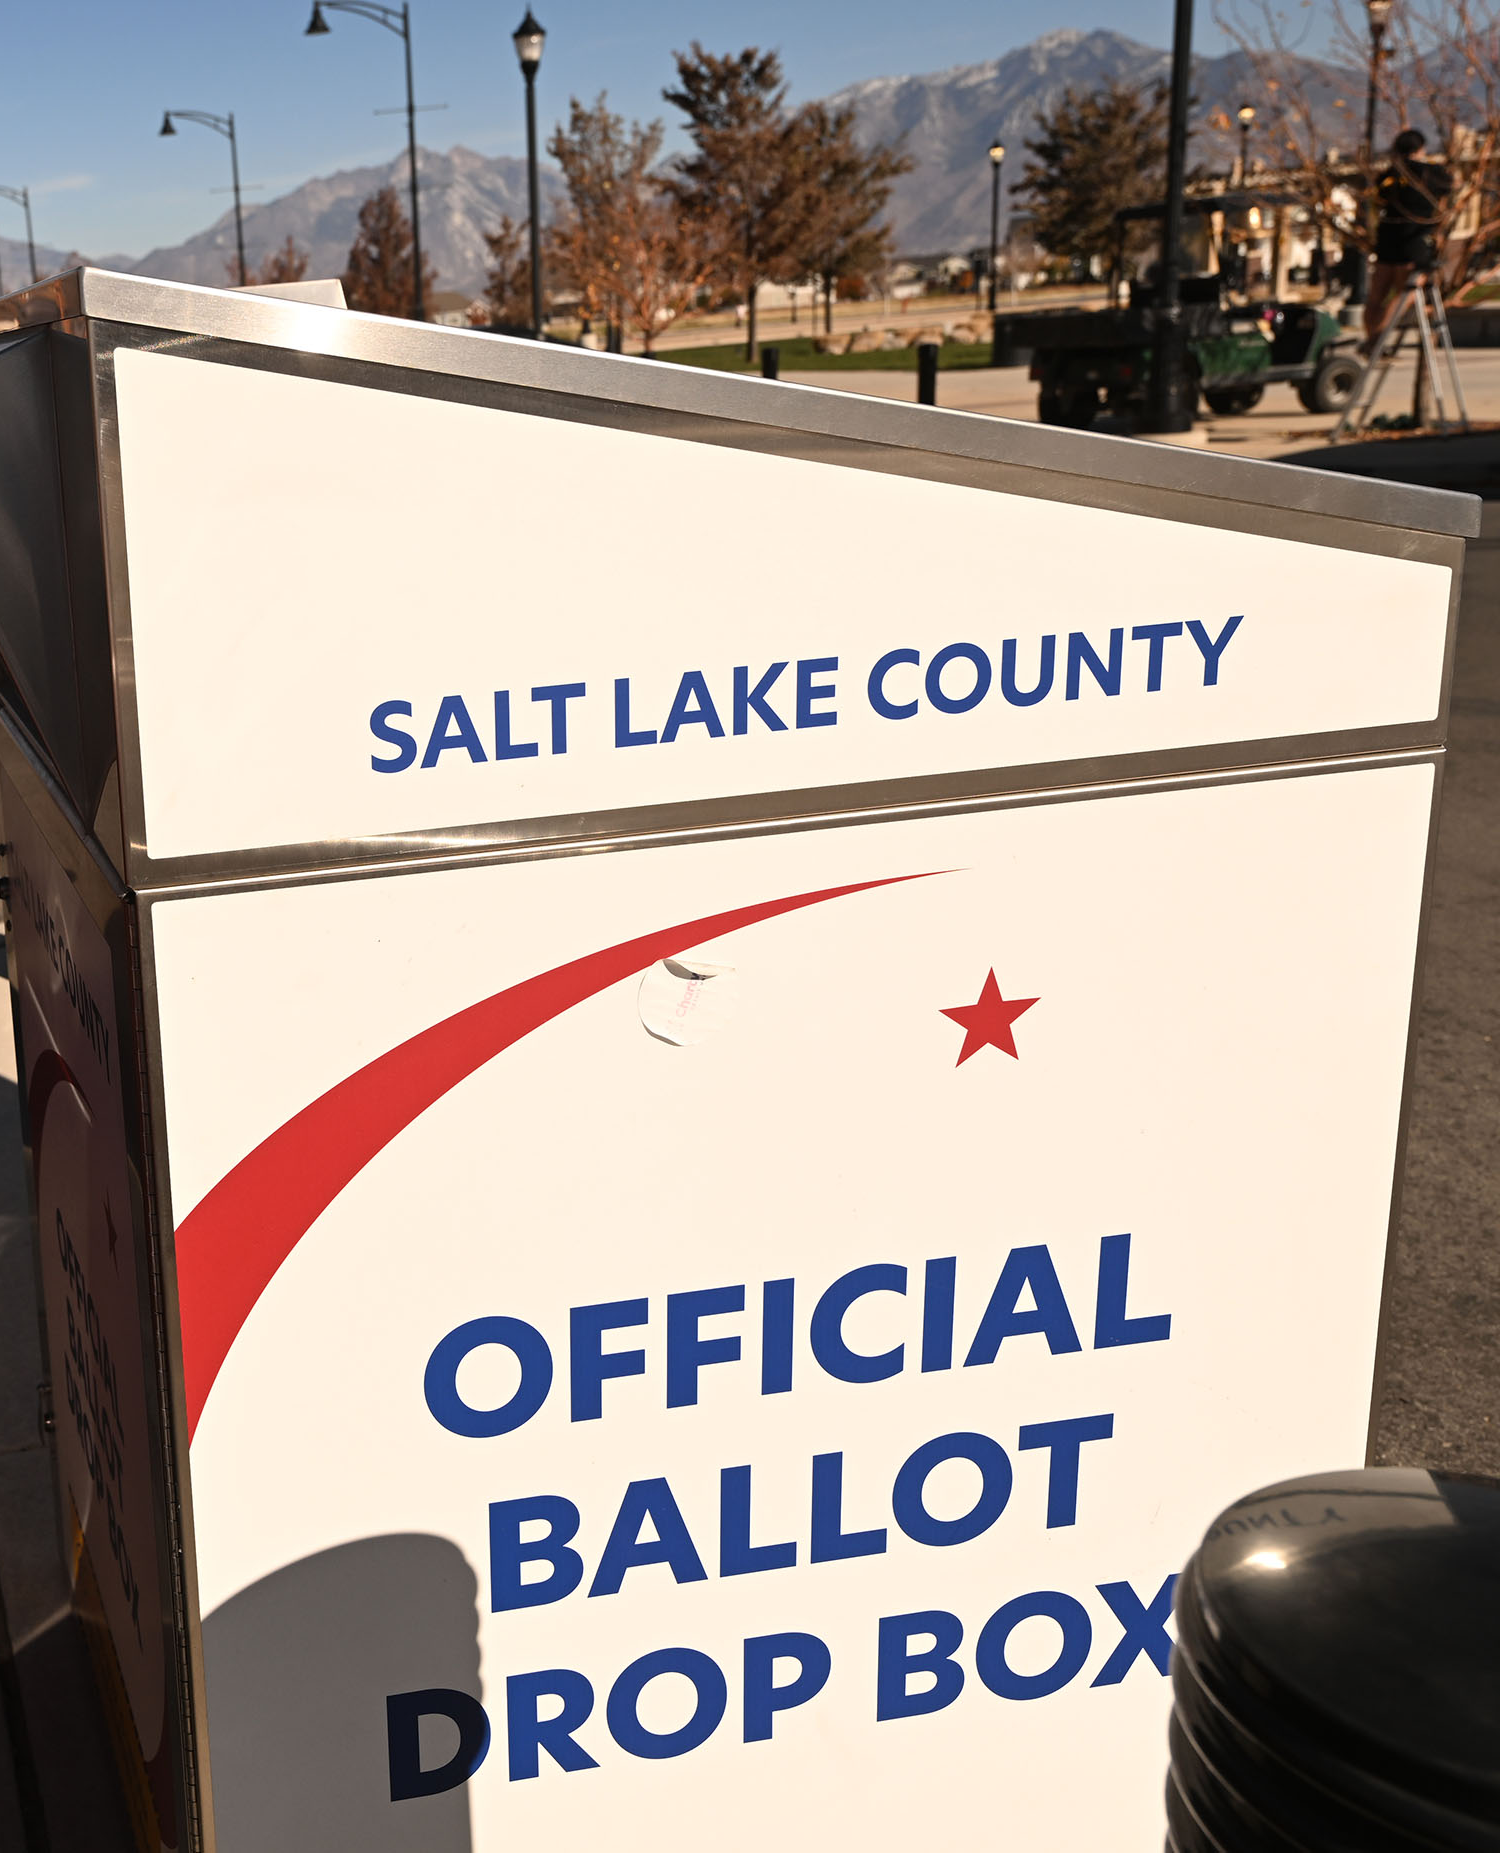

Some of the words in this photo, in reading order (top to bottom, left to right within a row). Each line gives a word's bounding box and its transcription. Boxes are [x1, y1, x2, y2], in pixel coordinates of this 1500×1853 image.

[371, 683, 585, 773] SALT
[616, 657, 838, 747] LAKE
[868, 616, 1244, 719] COUNTY
[58, 935, 111, 1086] COUNTY
[57, 1207, 124, 1446] OFFICIAL
[66, 1296, 123, 1513] BALLOT
[425, 1234, 1171, 1437] OFFICIAL
[64, 1351, 104, 1501] DROP
[106, 1482, 143, 1654] BOX
[490, 1414, 1113, 1612] BALLOT
[387, 1633, 831, 1802] DROP
[878, 1574, 1180, 1720] BOX
